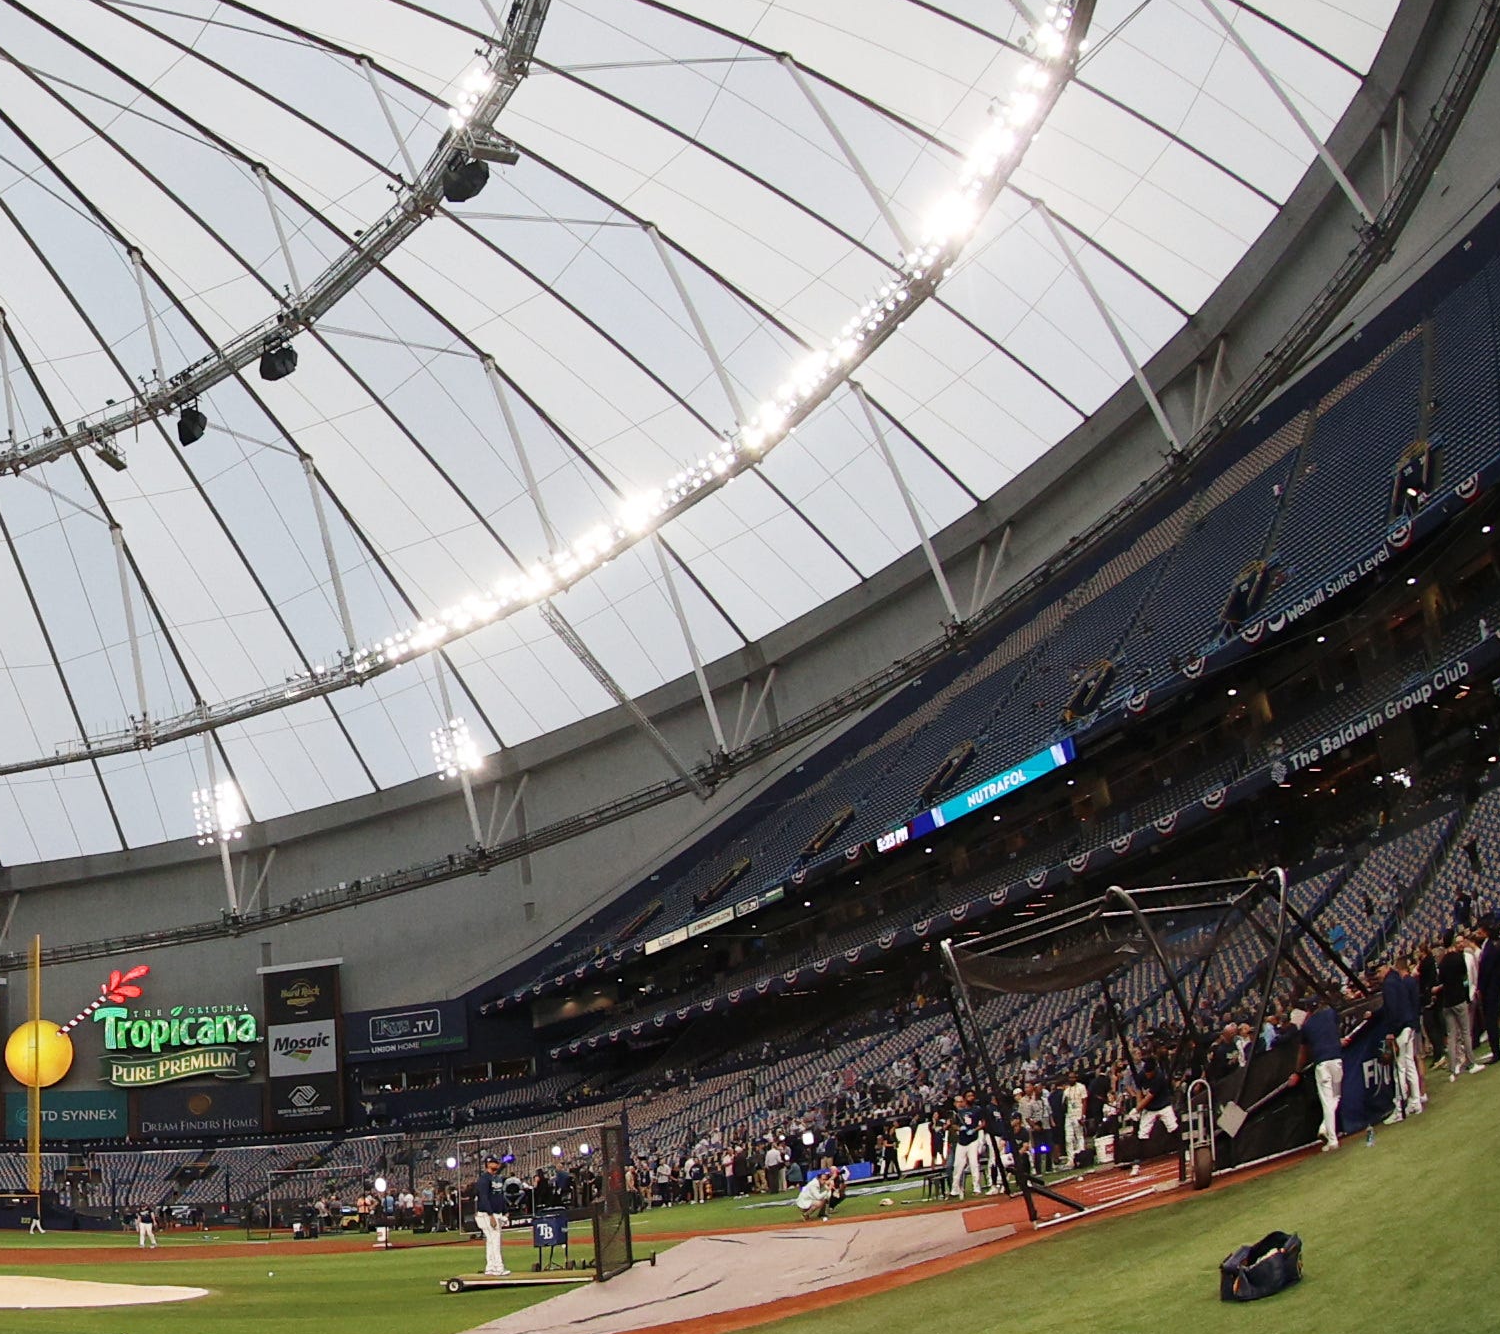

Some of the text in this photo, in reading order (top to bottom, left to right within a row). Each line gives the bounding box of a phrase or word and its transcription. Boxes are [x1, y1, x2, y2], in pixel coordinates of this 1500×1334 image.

[1285, 544, 1390, 622] Webull Suite Level
[1289, 660, 1469, 771] The Baldwin Group Club
[967, 769, 1027, 808] NUTRAFOL
[134, 1004, 249, 1018] THE ORIGINAL
[94, 1006, 257, 1053] Tropicana
[273, 1031, 330, 1052] Mosaic
[371, 1044, 397, 1055] UNION
[397, 1041, 421, 1051] HOME
[112, 1052, 237, 1082] PURE PREMIUM
[40, 1109, 117, 1122] TD SYNNEX
[142, 1117, 259, 1133] DREAM FINDERS HOMES
[537, 1223, 554, 1240] TB
